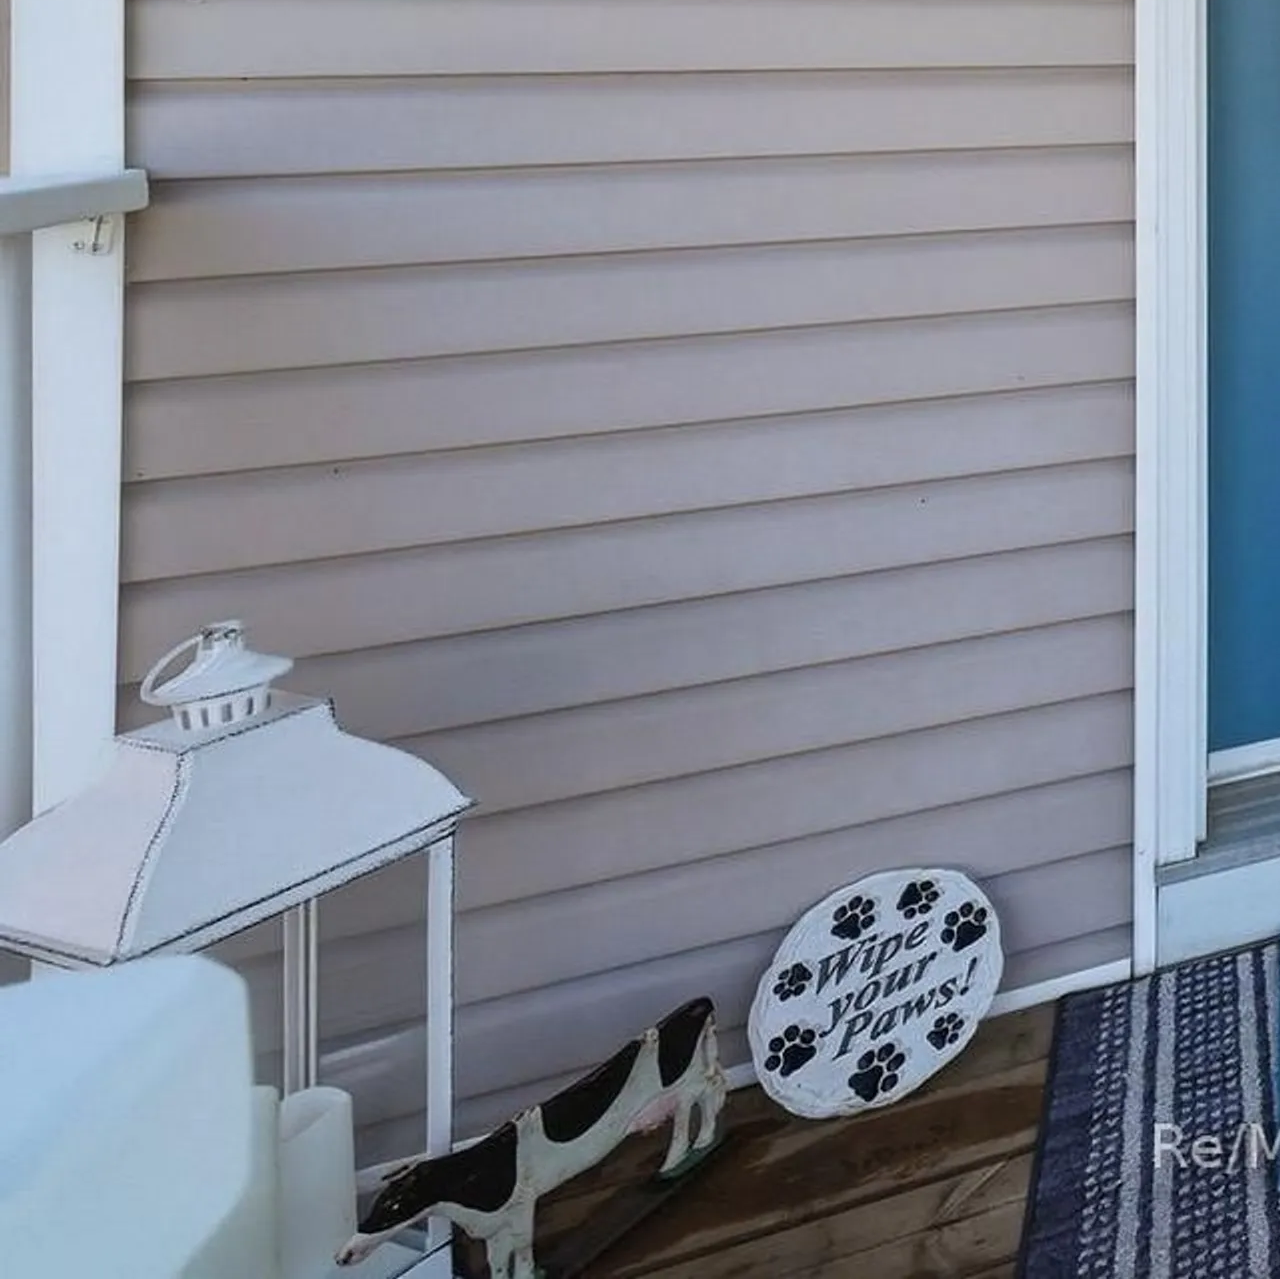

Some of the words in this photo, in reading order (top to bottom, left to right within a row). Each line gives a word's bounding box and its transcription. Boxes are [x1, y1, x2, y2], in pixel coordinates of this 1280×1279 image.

[814, 920, 930, 995] Wipe
[818, 951, 938, 1039] your
[832, 957, 978, 1061] paws!
